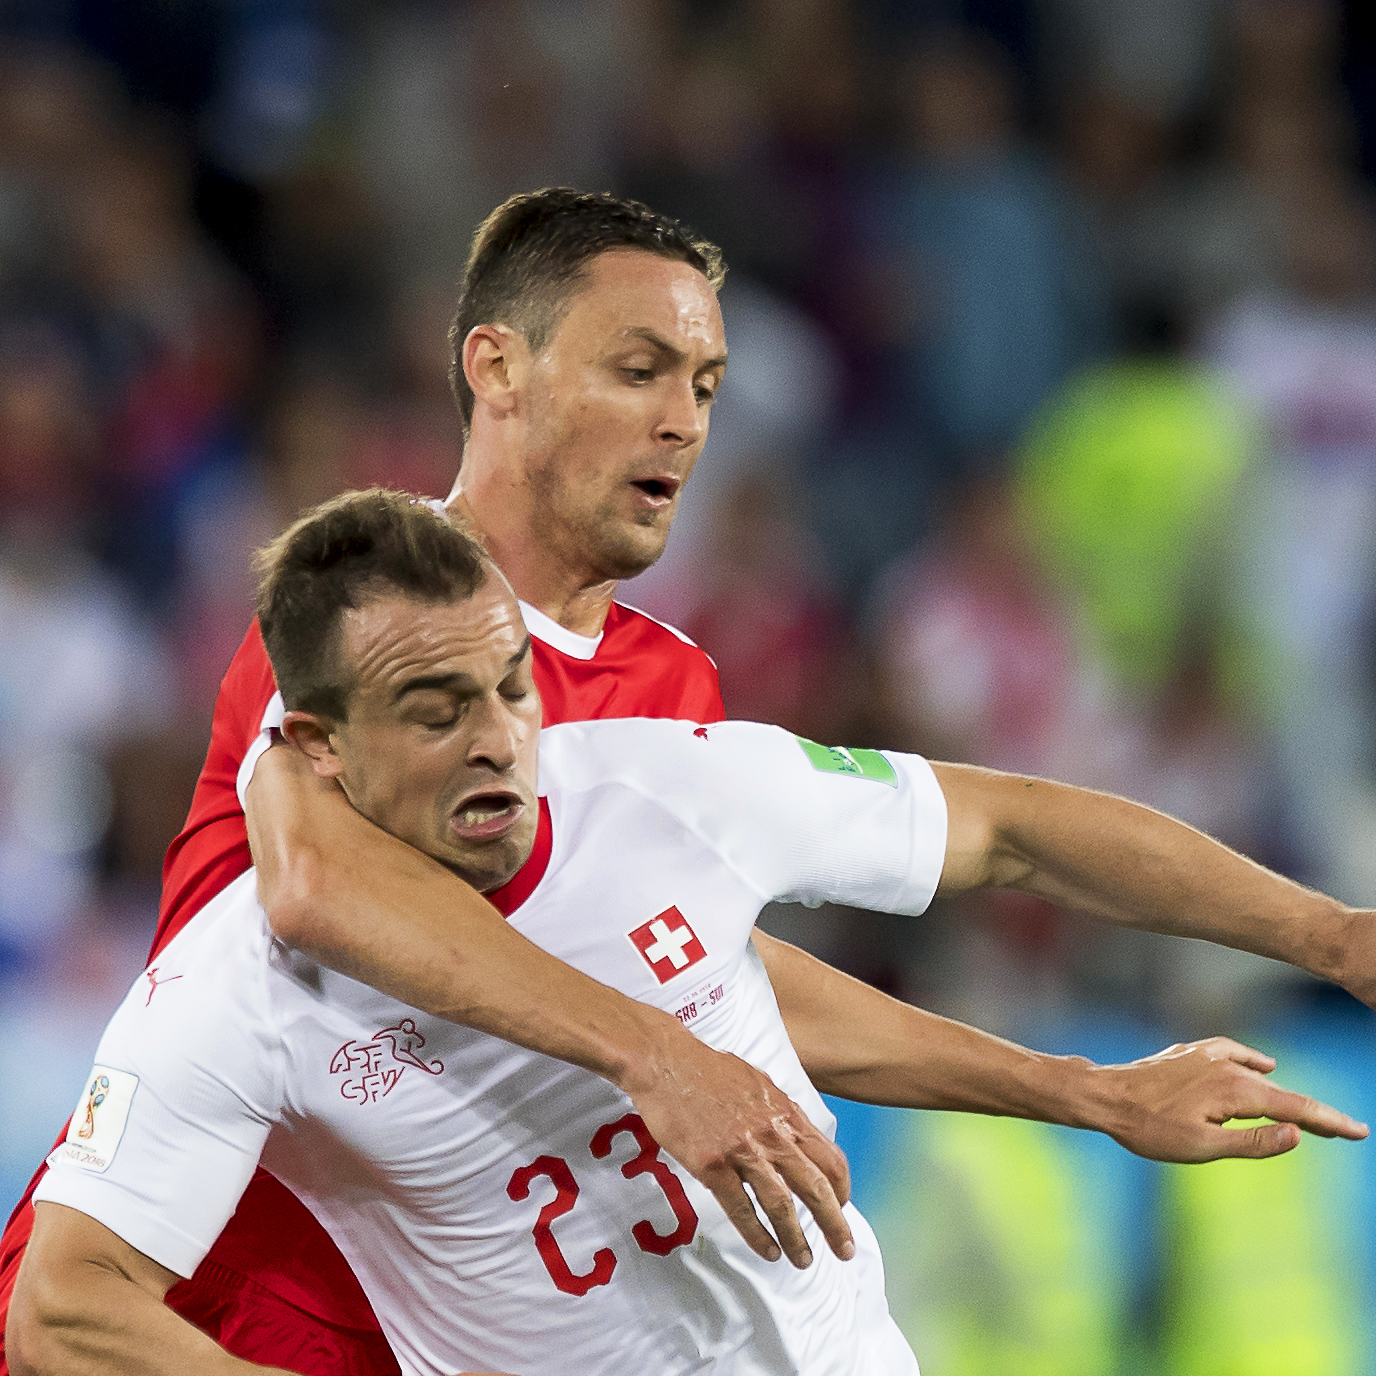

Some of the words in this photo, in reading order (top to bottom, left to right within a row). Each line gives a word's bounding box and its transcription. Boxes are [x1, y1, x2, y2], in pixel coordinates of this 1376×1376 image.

[675, 1002, 697, 1022] SRB
[709, 984, 723, 1005] SUI
[506, 1112, 699, 1298] 23
